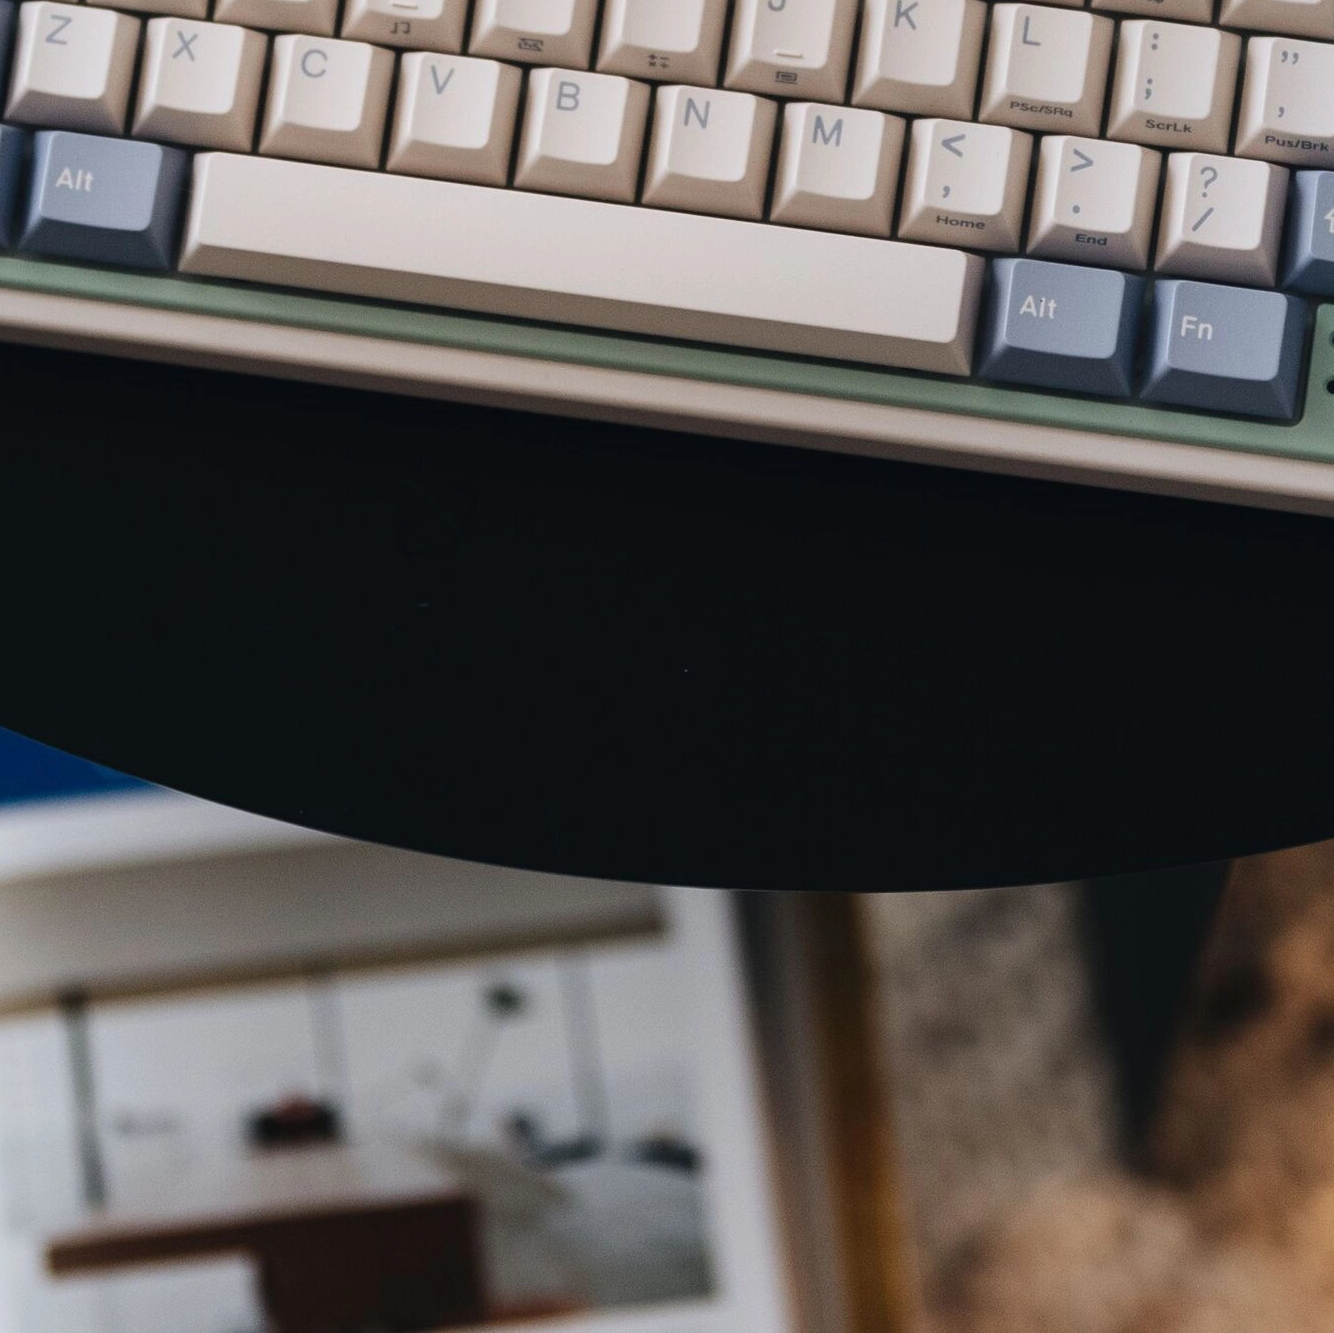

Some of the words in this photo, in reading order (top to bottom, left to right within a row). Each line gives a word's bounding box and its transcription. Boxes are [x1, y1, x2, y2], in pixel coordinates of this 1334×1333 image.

[894, 0, 918, 30] K
[45, 14, 72, 45] Z
[1022, 16, 1041, 46] L
[1151, 33, 1159, 50] :
[172, 31, 198, 61] X
[301, 49, 328, 78] C
[431, 65, 455, 95] V
[1145, 78, 1153, 100] ;
[556, 81, 580, 111] B
[684, 98, 710, 129] N
[1144, 117, 1194, 135] ScrLk
[812, 115, 843, 147] M
[941, 134, 966, 157] <
[1264, 134, 1331, 154] Pus/Brk
[1071, 149, 1094, 172] >
[55, 167, 93, 191] Alt
[1200, 166, 1218, 198] ?
[935, 215, 987, 231] Home
[1192, 207, 1214, 232] /
[1075, 233, 1108, 246] End
[1181, 315, 1213, 340] Fn
